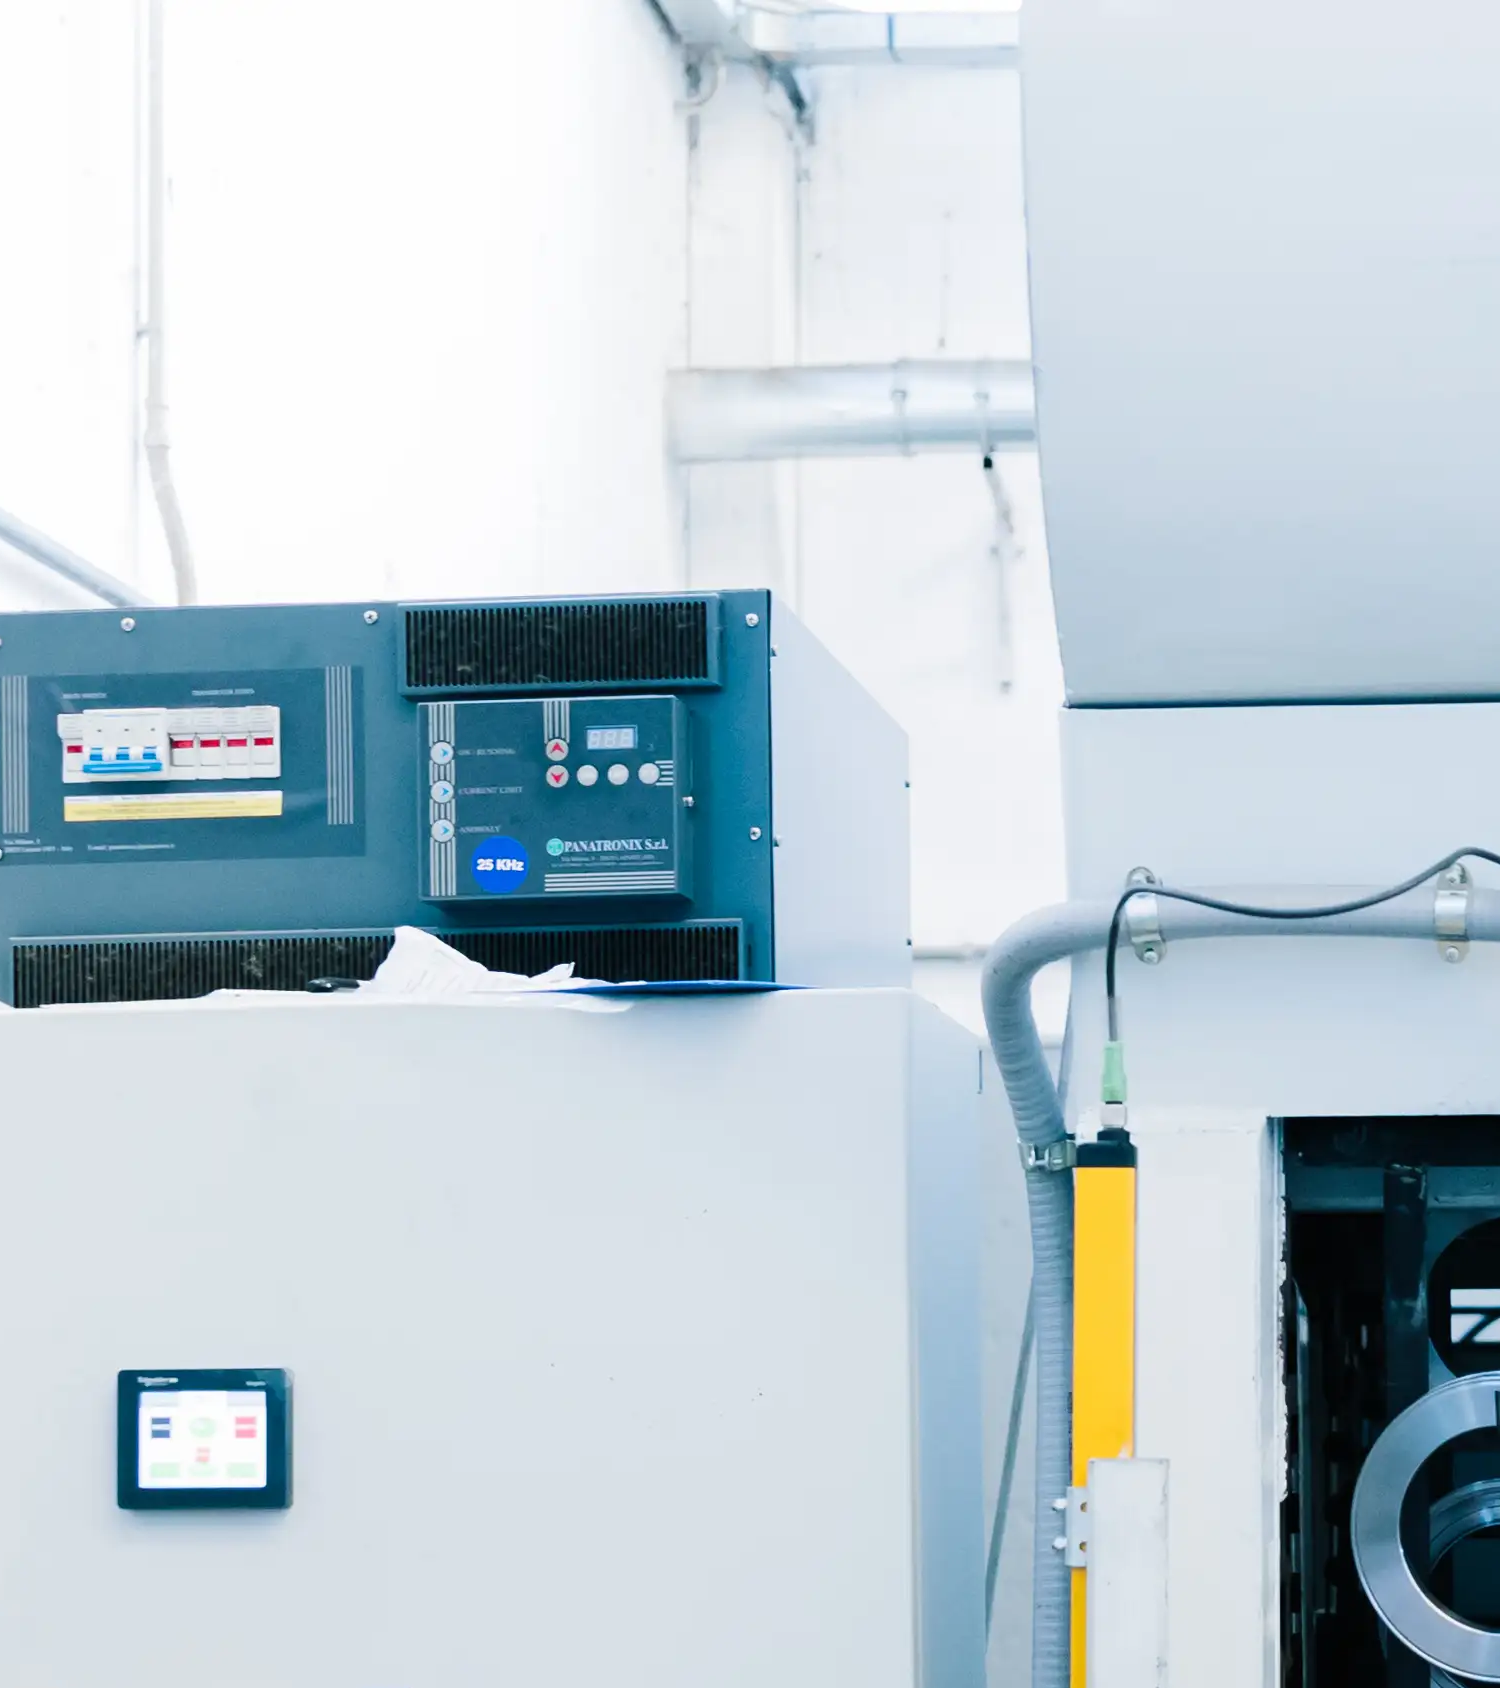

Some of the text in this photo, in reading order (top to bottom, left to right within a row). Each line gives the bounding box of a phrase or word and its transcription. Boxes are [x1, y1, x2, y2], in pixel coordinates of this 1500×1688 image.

[564, 839, 643, 852] PANATRONIX
[476, 858, 524, 871] 25 KHz
